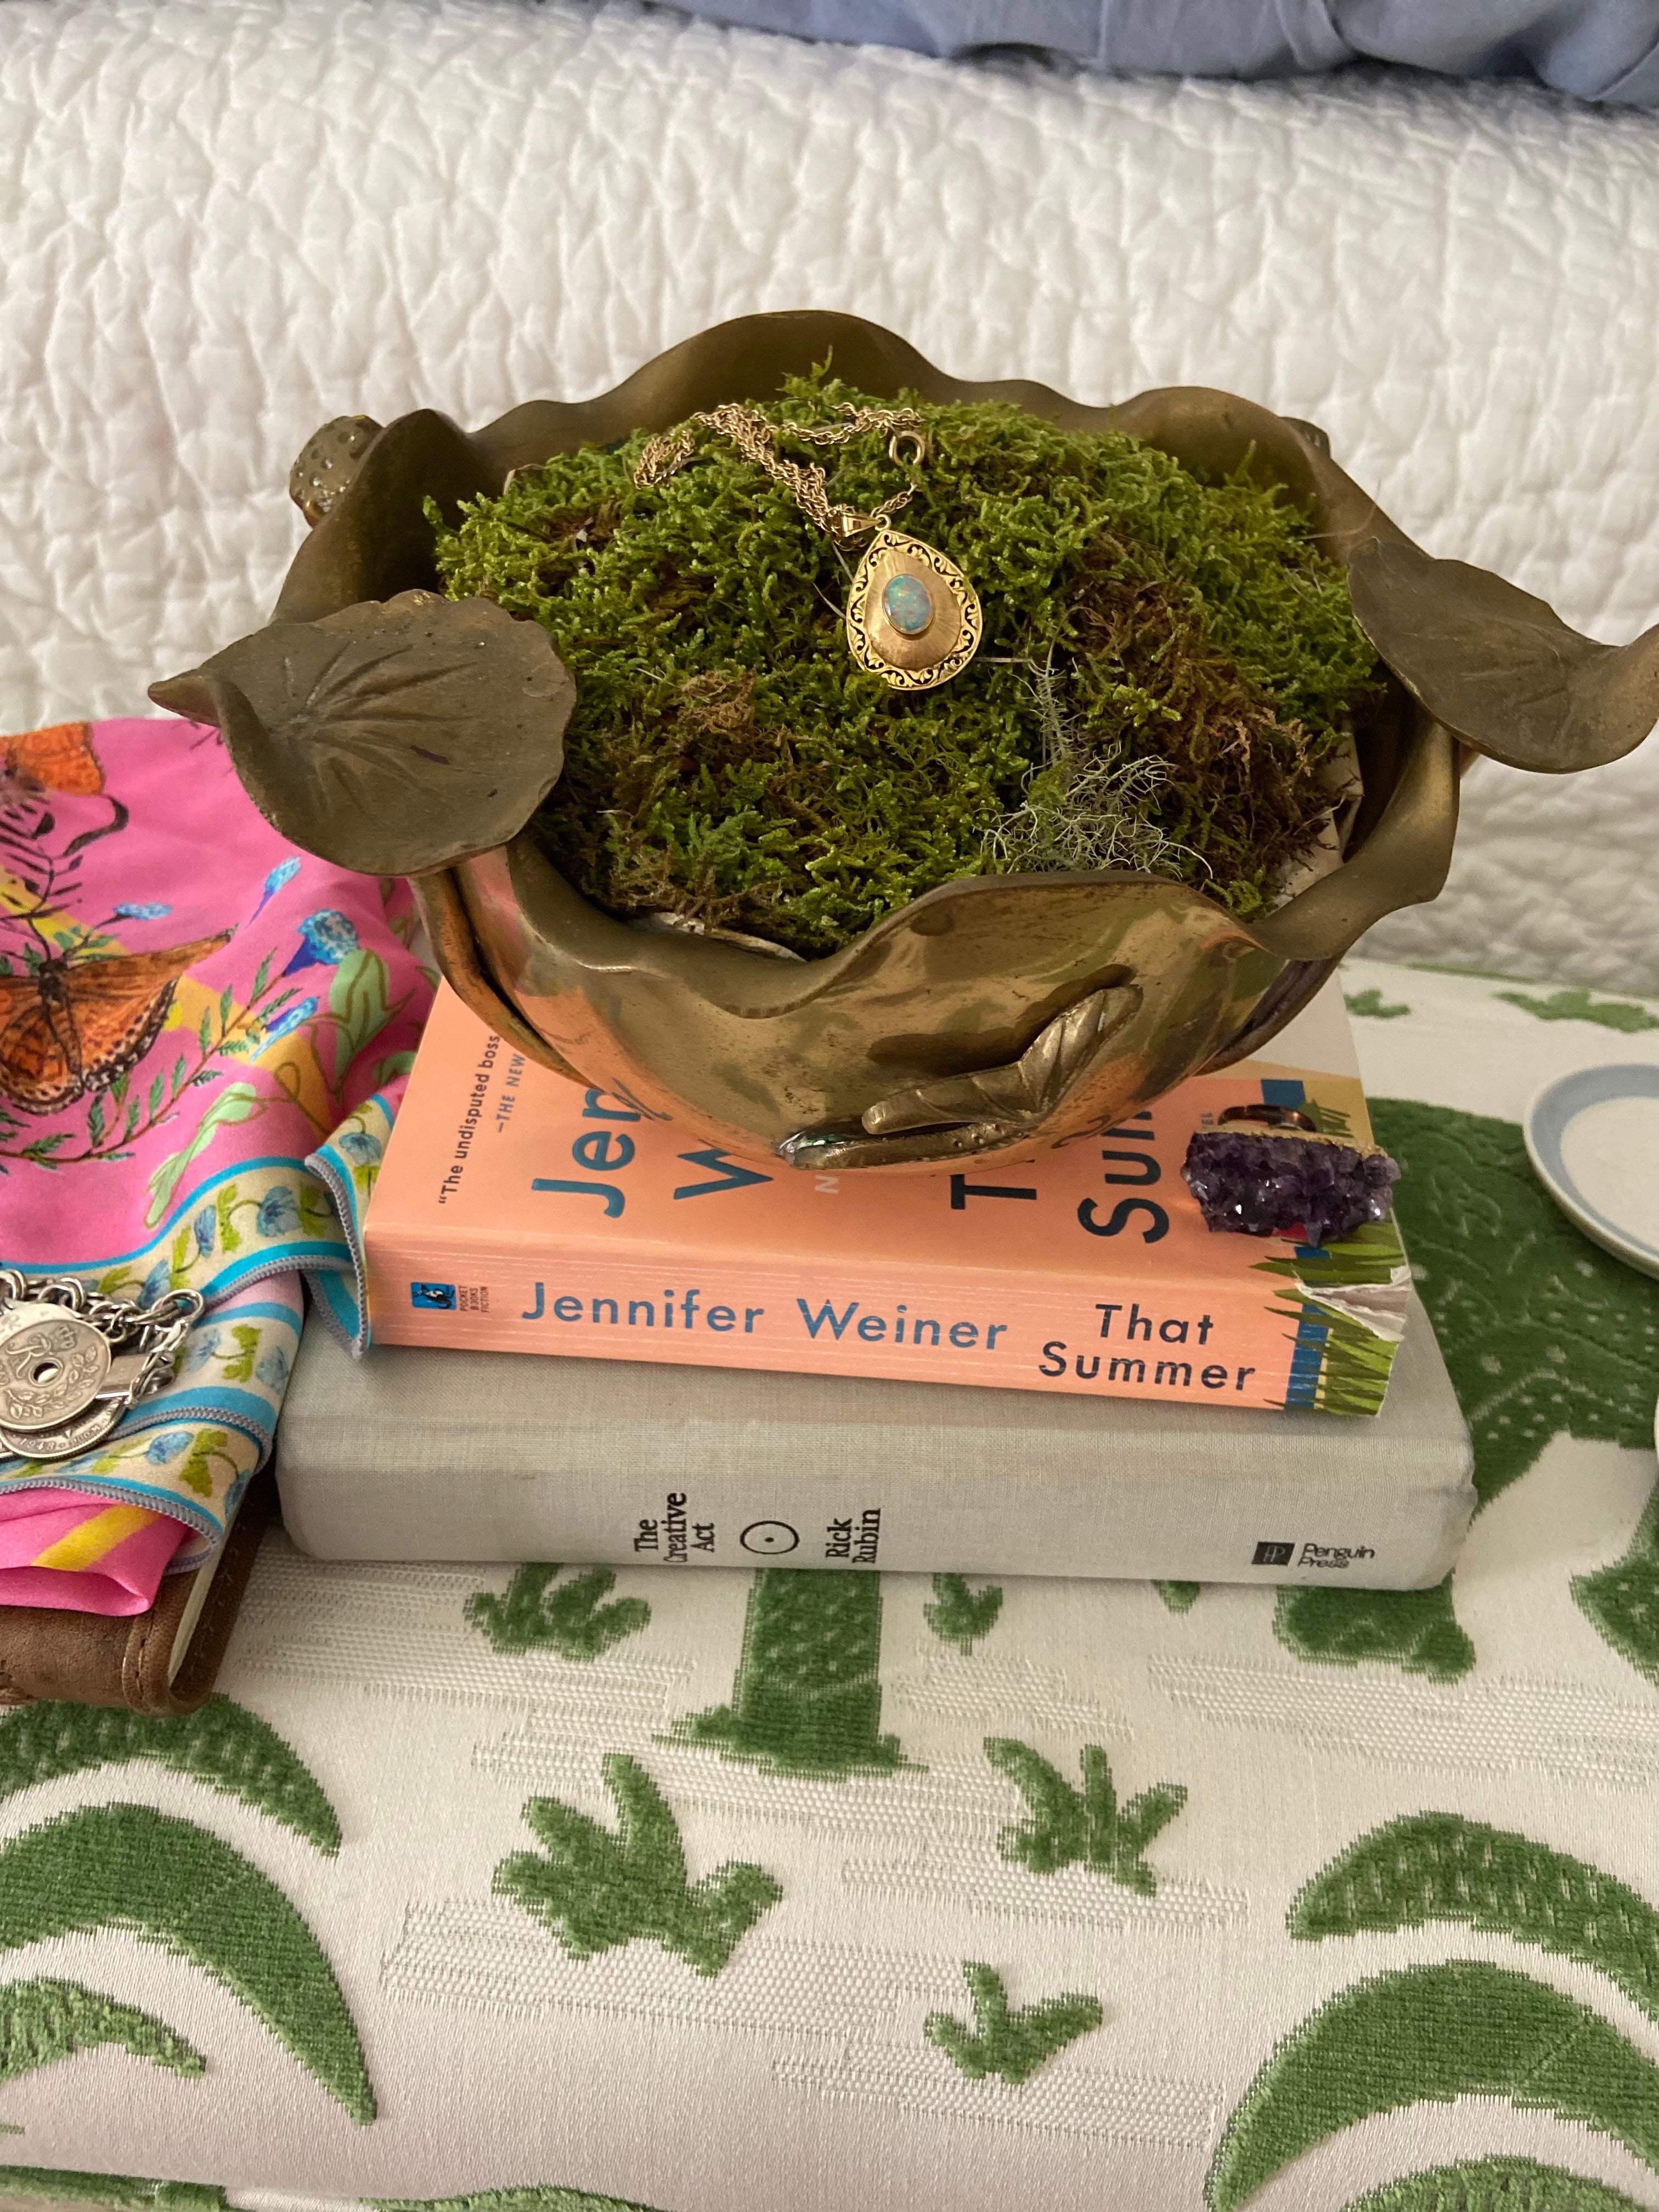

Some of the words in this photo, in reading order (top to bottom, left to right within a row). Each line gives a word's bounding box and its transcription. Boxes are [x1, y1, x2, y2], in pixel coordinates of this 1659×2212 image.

[505, 1053, 526, 1088] NEW
[455, 1074, 490, 1159] undisputed
[478, 1035, 501, 1069] boss
[459, 1285, 469, 1312] POCKET
[469, 1288, 479, 1311] BOOKS
[480, 1286, 490, 1313] FICTION
[521, 1282, 765, 1334] Jennifer
[796, 1298, 1008, 1350] Weiner
[1095, 1303, 1214, 1345] That
[1038, 1340, 1256, 1391] Summer
[634, 1518, 659, 1552] The
[661, 1492, 688, 1563] Creative
[690, 1522, 715, 1553] Act
[825, 1517, 853, 1558] Rick
[852, 1508, 881, 1564] Rubin
[1297, 1557, 1350, 1568] Press
[1302, 1542, 1375, 1559] Penguin
